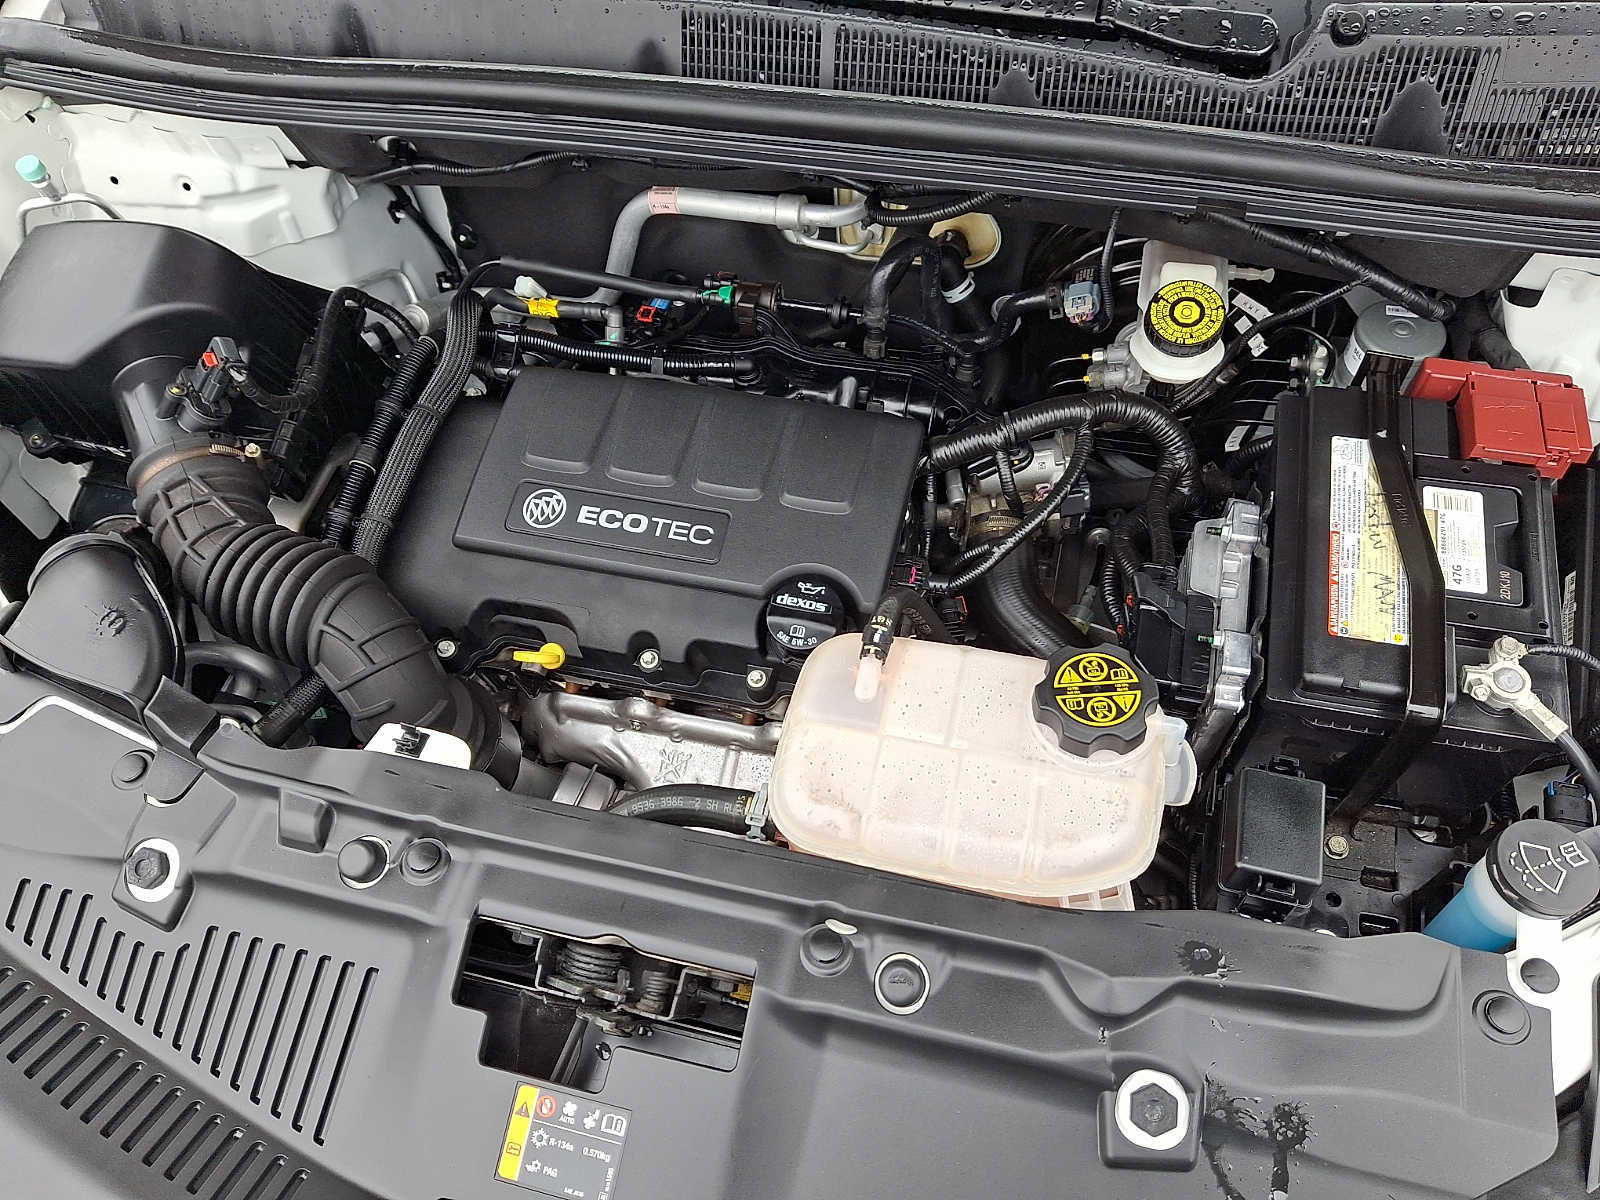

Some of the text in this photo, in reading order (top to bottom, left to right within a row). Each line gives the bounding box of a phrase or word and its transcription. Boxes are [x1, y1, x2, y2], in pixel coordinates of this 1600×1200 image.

[576, 505, 715, 546] ECOTEC
[1451, 564, 1462, 585] 47G
[776, 593, 829, 612] dexos
[776, 630, 818, 646] SAE 5W-30
[582, 1146, 611, 1163] 0.570kg
[542, 1165, 558, 1178] PAG
